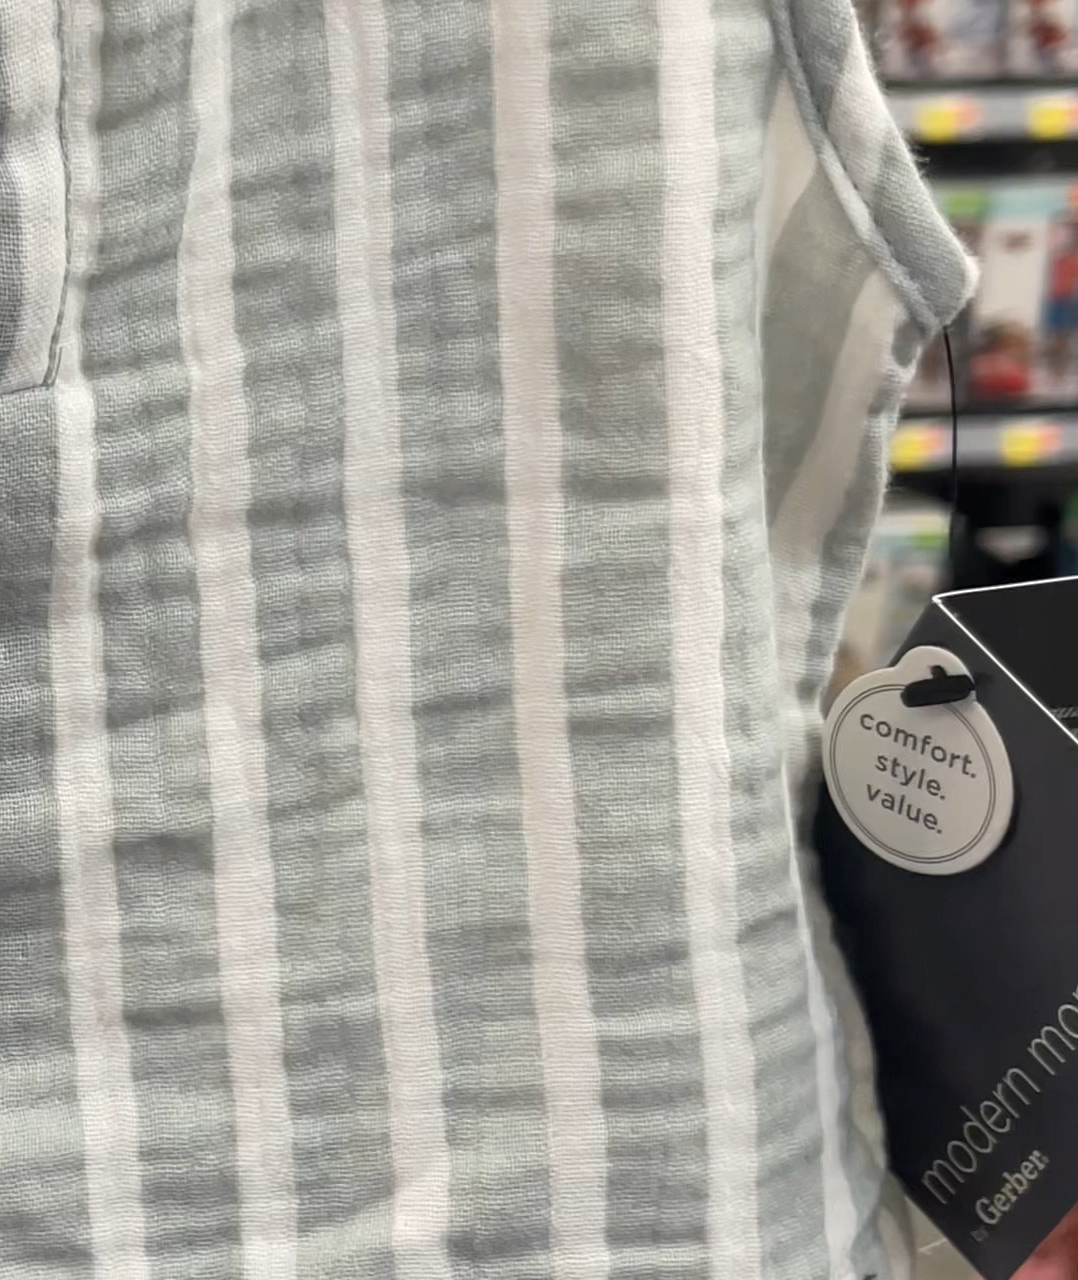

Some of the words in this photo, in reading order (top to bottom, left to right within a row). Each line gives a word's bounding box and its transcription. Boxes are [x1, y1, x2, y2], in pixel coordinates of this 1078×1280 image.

[859, 713, 977, 779] comfort.
[874, 754, 946, 801] style.
[866, 783, 943, 835] value.
[921, 1067, 1042, 1205] modern
